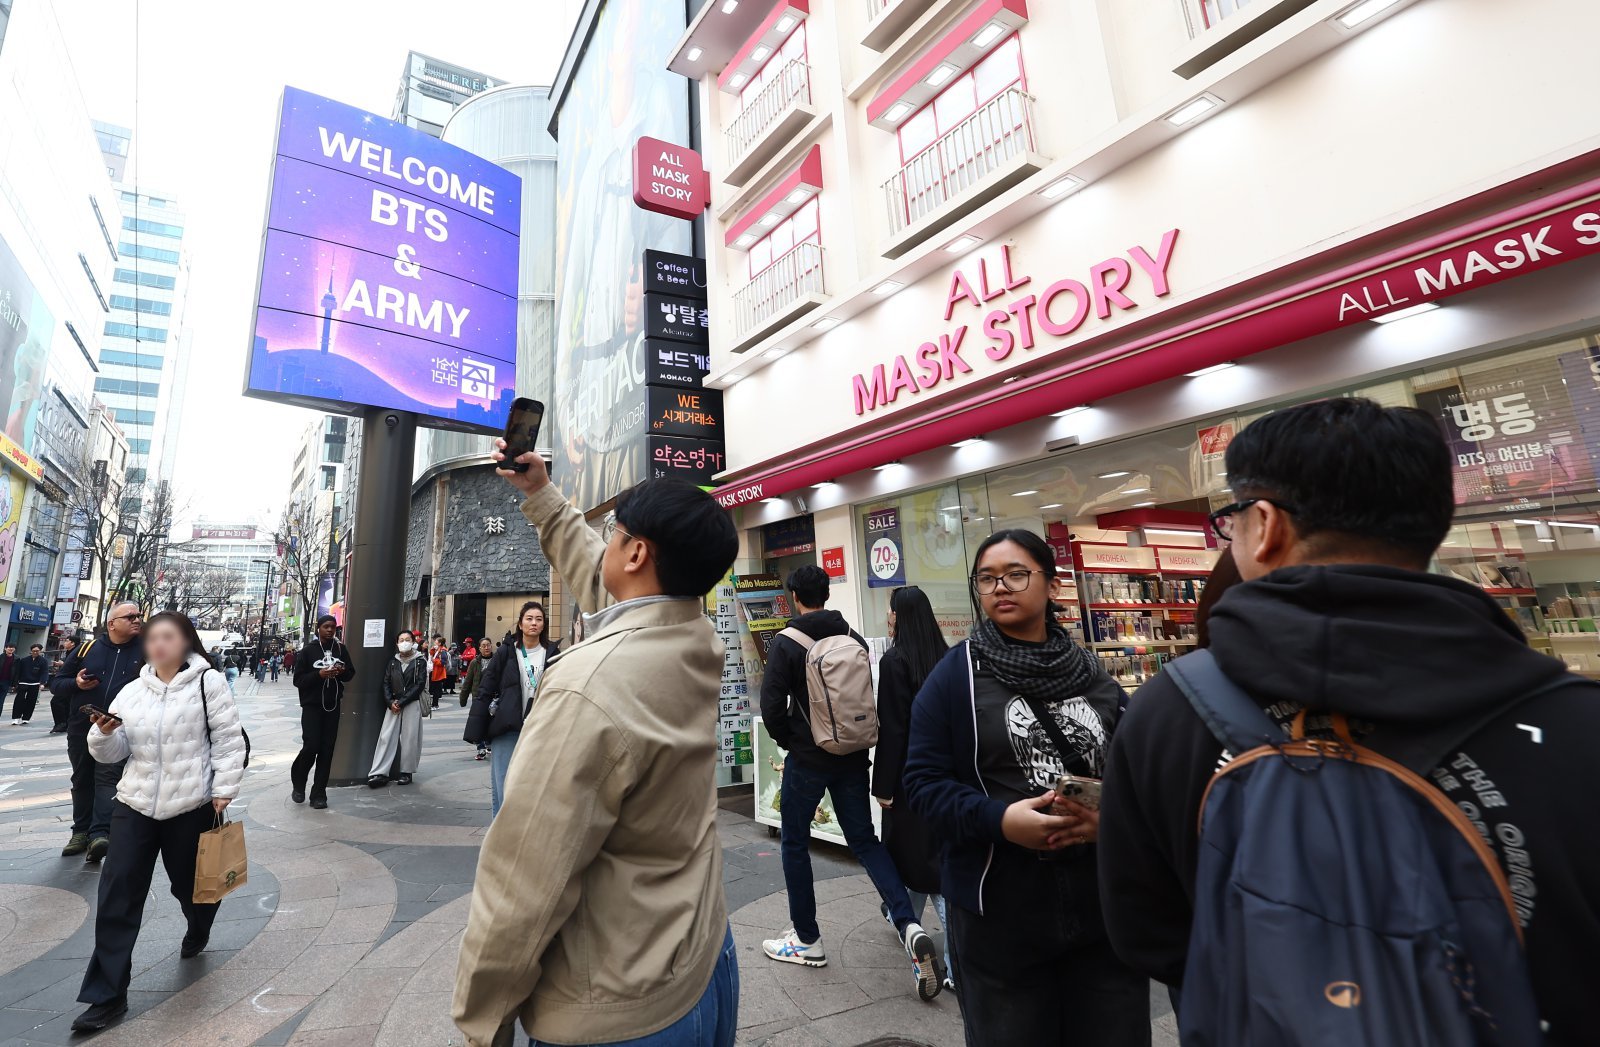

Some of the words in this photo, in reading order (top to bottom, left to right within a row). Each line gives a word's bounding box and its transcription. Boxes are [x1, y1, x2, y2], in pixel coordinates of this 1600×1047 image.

[659, 150, 684, 168] ALL
[318, 126, 495, 216] WELCOME
[651, 165, 690, 187] MASK
[651, 181, 693, 203] STORY
[370, 188, 449, 243] BTS
[393, 243, 422, 281] &
[656, 261, 689, 274] Coffee
[1338, 279, 1410, 322] ALL
[1413, 225, 1563, 296] MASK
[1572, 208, 1600, 246] S
[657, 273, 664, 281] &
[667, 274, 689, 285] Beer
[943, 244, 1032, 321] ALL
[341, 278, 471, 340] ARMY
[851, 324, 974, 416] MASK
[982, 228, 1181, 362] STORY
[662, 327, 694, 337] Alcatraz
[431, 369, 458, 387] 1545
[660, 373, 693, 383] MONACO
[1448, 383, 1503, 401] WELCOME
[677, 393, 700, 409] WE
[653, 421, 664, 429] 6F
[662, 409, 716, 426] 시계거래소
[1451, 392, 1537, 442] 명동
[653, 444, 723, 471] 약손명가
[1482, 460, 1535, 477] 환영합니다
[737, 484, 764, 503] STORY
[868, 515, 896, 531] SALE
[873, 545, 898, 564] 70%
[1096, 554, 1128, 563] MEDIHEAL
[1169, 557, 1199, 565] MEDIHEAL
[826, 558, 842, 569] 에스원
[874, 564, 885, 573] UP
[885, 563, 896, 572] TO
[754, 579, 781, 588] Massage
[720, 605, 728, 613] B1
[720, 621, 729, 629] 1F
[722, 686, 731, 694] 6F
[723, 703, 732, 712] 6F
[724, 721, 733, 729] 7F
[724, 738, 734, 746] 8F
[725, 755, 734, 764] 9F
[1451, 752, 1508, 809] THE
